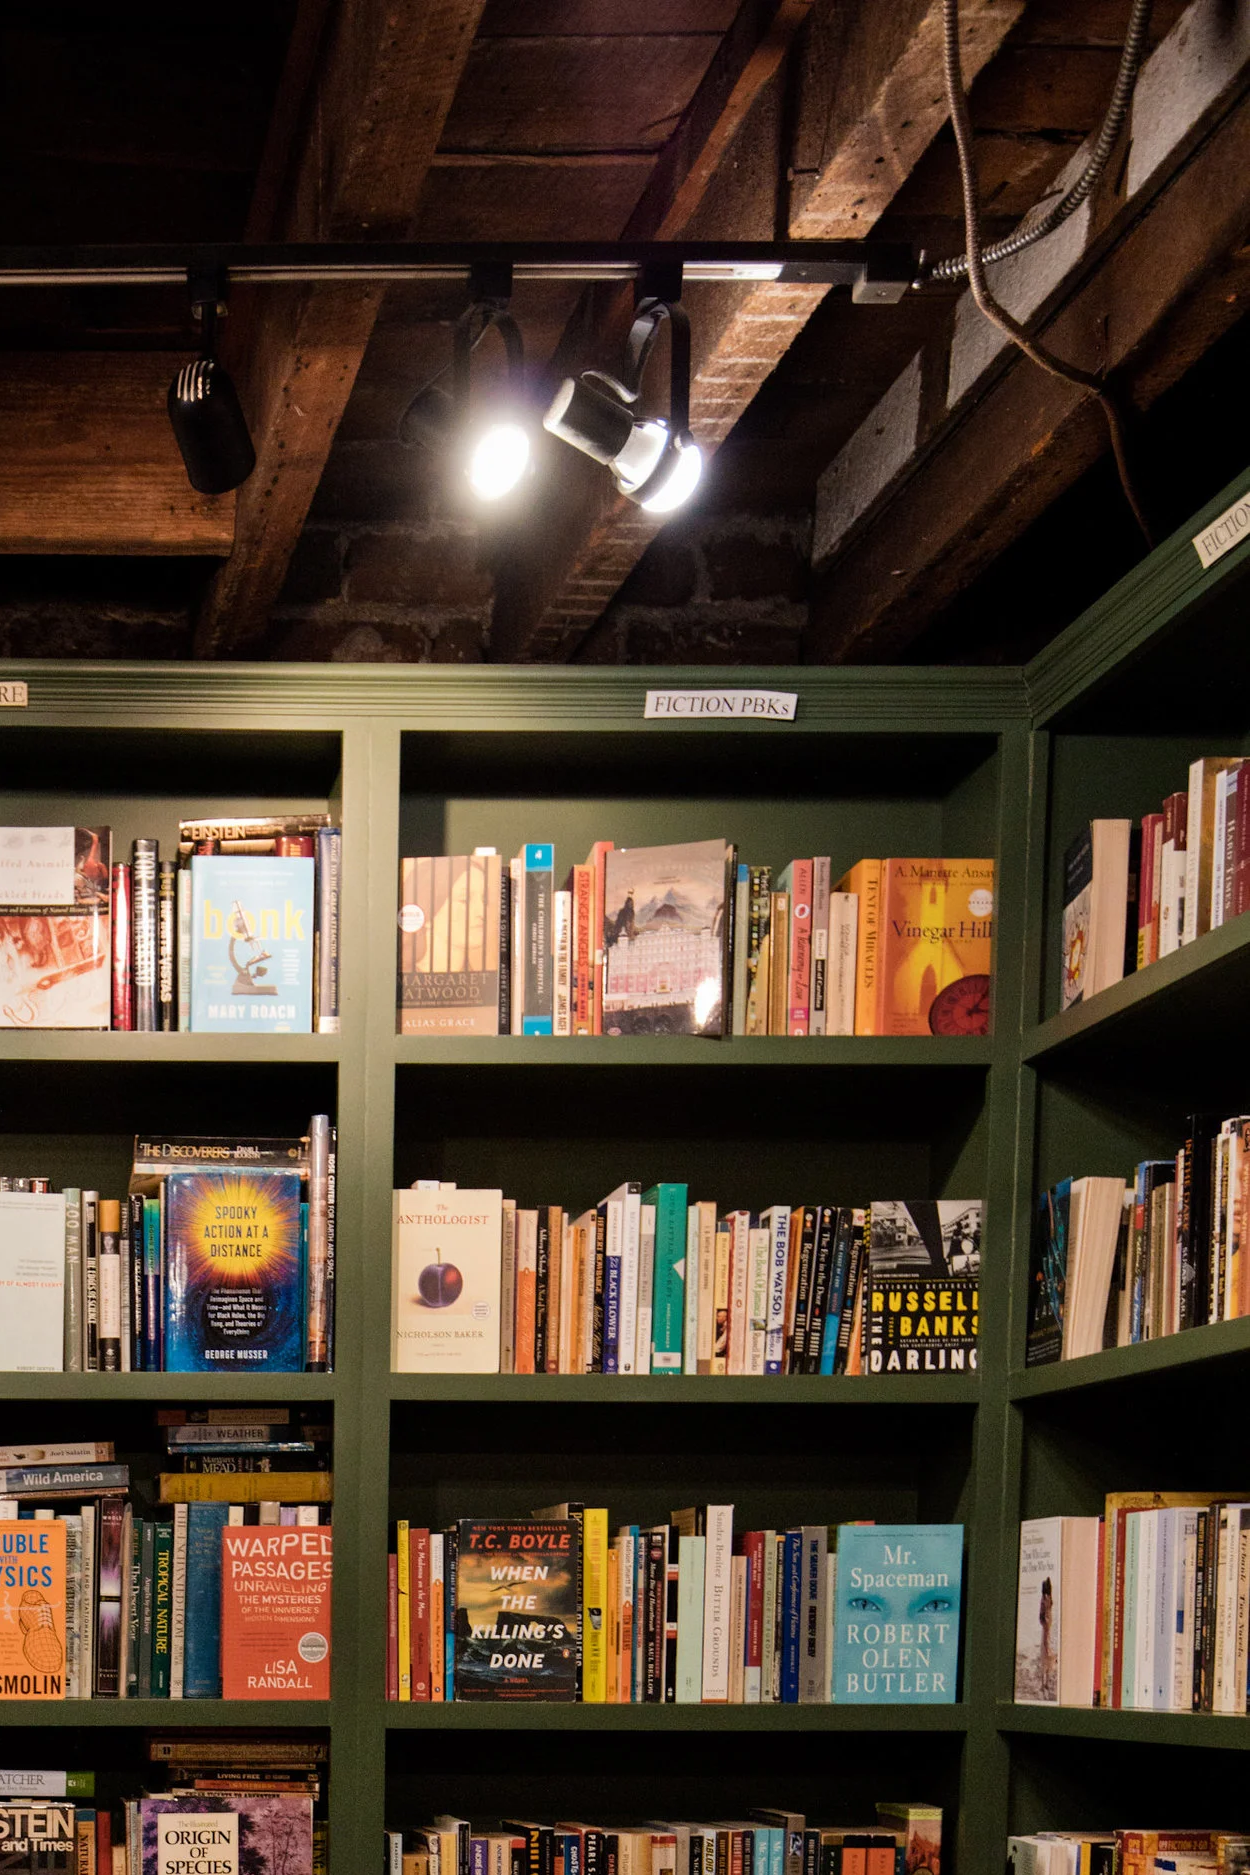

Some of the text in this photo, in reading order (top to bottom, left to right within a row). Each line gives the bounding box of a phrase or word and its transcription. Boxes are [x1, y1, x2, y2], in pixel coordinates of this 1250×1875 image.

[1201, 502, 1250, 557] FICTIO
[654, 695, 736, 714] FICTION
[203, 899, 305, 939] bonk
[893, 921, 993, 944] Vinegar Hill
[207, 1004, 296, 1020] MARY ROACH
[215, 1205, 258, 1220] SPOOKY
[396, 1214, 491, 1226] ANTHOLOGIST
[204, 1224, 269, 1239] ACTION AT A
[210, 1243, 263, 1258] DISTANCE
[871, 1316, 883, 1345] THE
[899, 1315, 979, 1337] BANKS
[204, 1349, 269, 1360] GEORGE MUSSER
[23, 1469, 104, 1486] Wild America
[226, 1532, 333, 1557] WARPED
[469, 1534, 572, 1550] T.C. BOYLE
[883, 1544, 917, 1566] Mr.
[231, 1560, 333, 1581] PASSAGES
[490, 1565, 549, 1581] WHEN
[850, 1566, 949, 1591] Spaceman
[234, 1580, 327, 1594] UNRAVELING
[500, 1595, 537, 1610] THE
[470, 1623, 565, 1640] KILLING'S
[845, 1623, 950, 1645] ROBERT
[489, 1653, 545, 1669] DONE
[861, 1648, 932, 1669] OLEN
[264, 1659, 298, 1675] LISA
[247, 1676, 313, 1689] RANDALL
[845, 1672, 947, 1693] BUTLER
[1, 1837, 29, 1852] and
[31, 1837, 75, 1853] Times
[164, 1830, 232, 1845] ORIGIN
[189, 1847, 208, 1858] OF
[165, 1860, 233, 1875] SPECIES
